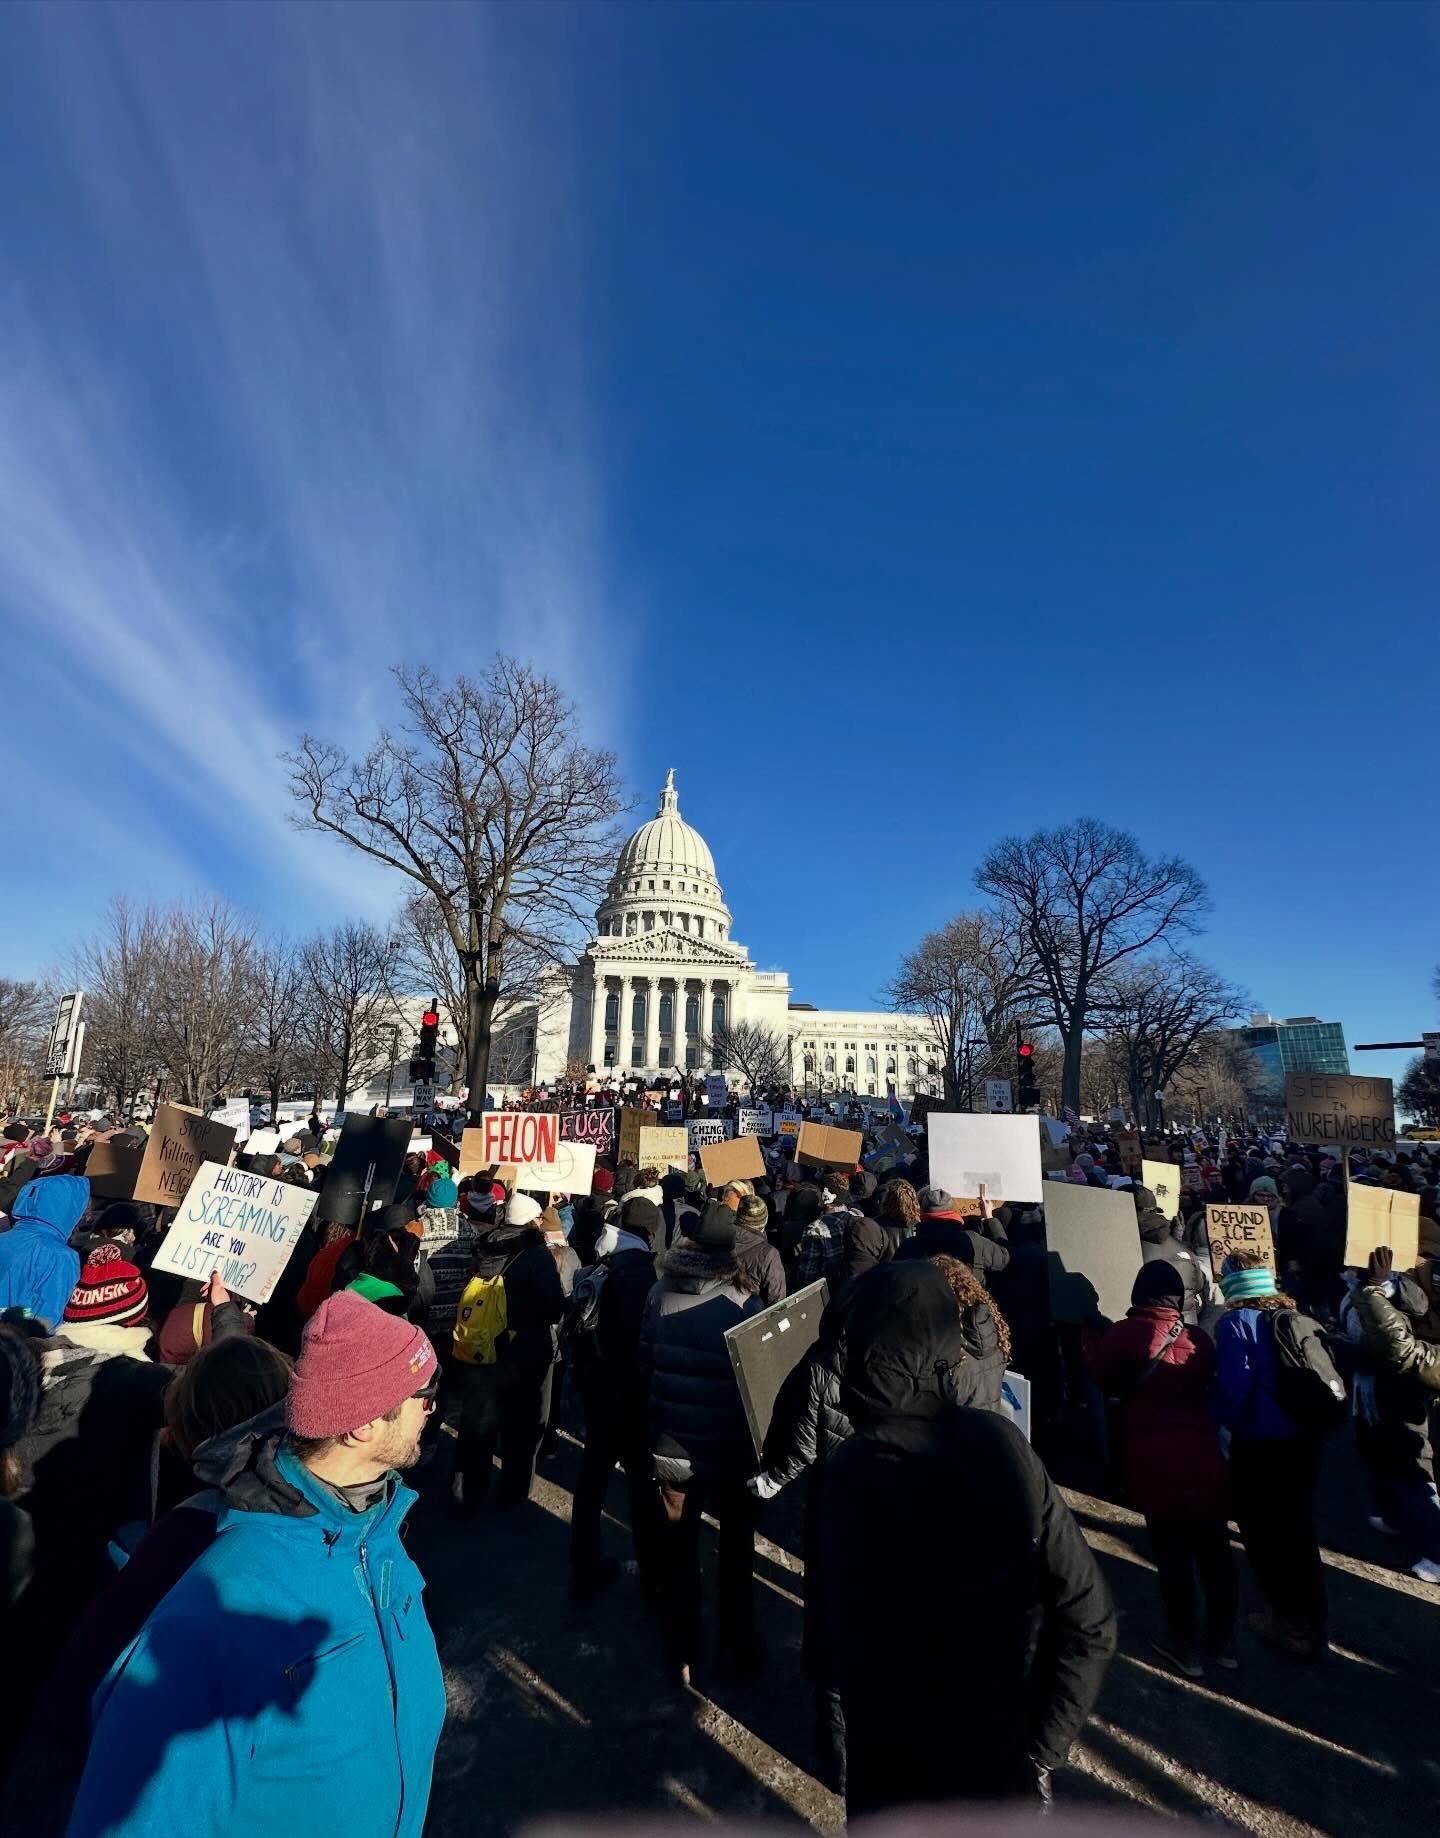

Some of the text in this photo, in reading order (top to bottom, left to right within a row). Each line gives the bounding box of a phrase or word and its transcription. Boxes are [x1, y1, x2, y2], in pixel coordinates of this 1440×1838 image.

[417, 1087, 433, 1095] ONE
[1293, 1077, 1389, 1102] SEE YOU
[1332, 1101, 1347, 1110] IN
[180, 1119, 211, 1141] STOP
[561, 1111, 612, 1137] FUCK
[691, 1125, 728, 1135] CHINGA
[1288, 1112, 1393, 1142] NUREMBERG
[484, 1114, 557, 1163] FELON
[689, 1137, 698, 1146] LA
[160, 1135, 194, 1174] Killing
[213, 1169, 285, 1207] HISTORY IS
[188, 1190, 290, 1243] SCREAMING
[1211, 1209, 1264, 1226] DEFUND
[201, 1230, 246, 1256] ARE YOU
[1220, 1223, 1257, 1241] ICE
[171, 1242, 257, 1289] LISTENING?
